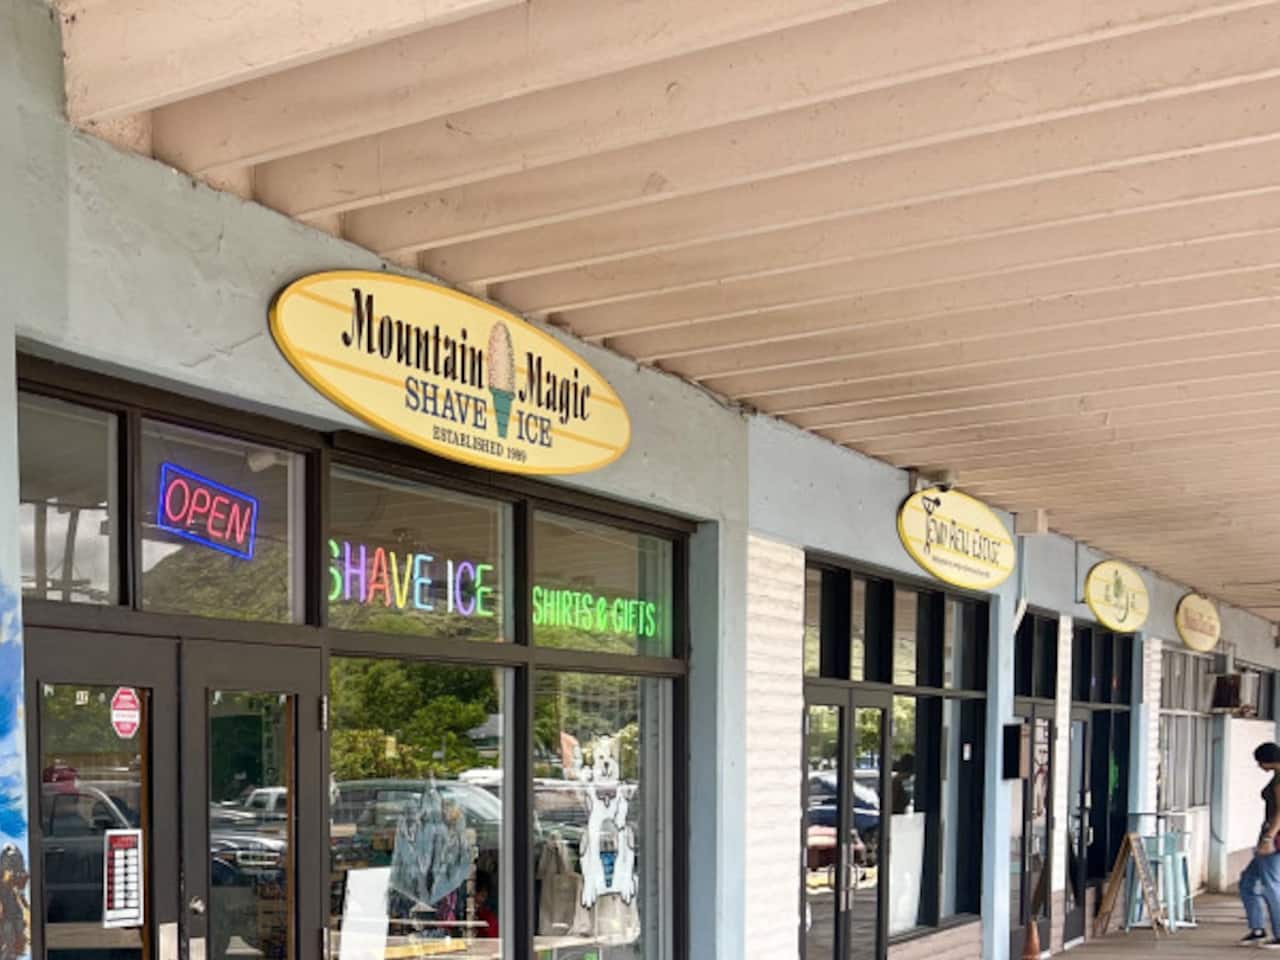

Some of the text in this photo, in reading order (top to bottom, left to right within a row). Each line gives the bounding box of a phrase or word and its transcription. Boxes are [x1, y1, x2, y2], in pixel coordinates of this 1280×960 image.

[341, 287, 591, 424] Mountain Magic
[404, 376, 552, 448] SHAVE ICE
[432, 425, 504, 457] ESTABLISHED
[165, 478, 252, 545] OPEN
[446, 559, 495, 617] ICE
[532, 585, 594, 632] SHIRTS
[613, 597, 657, 638] GIFTS
